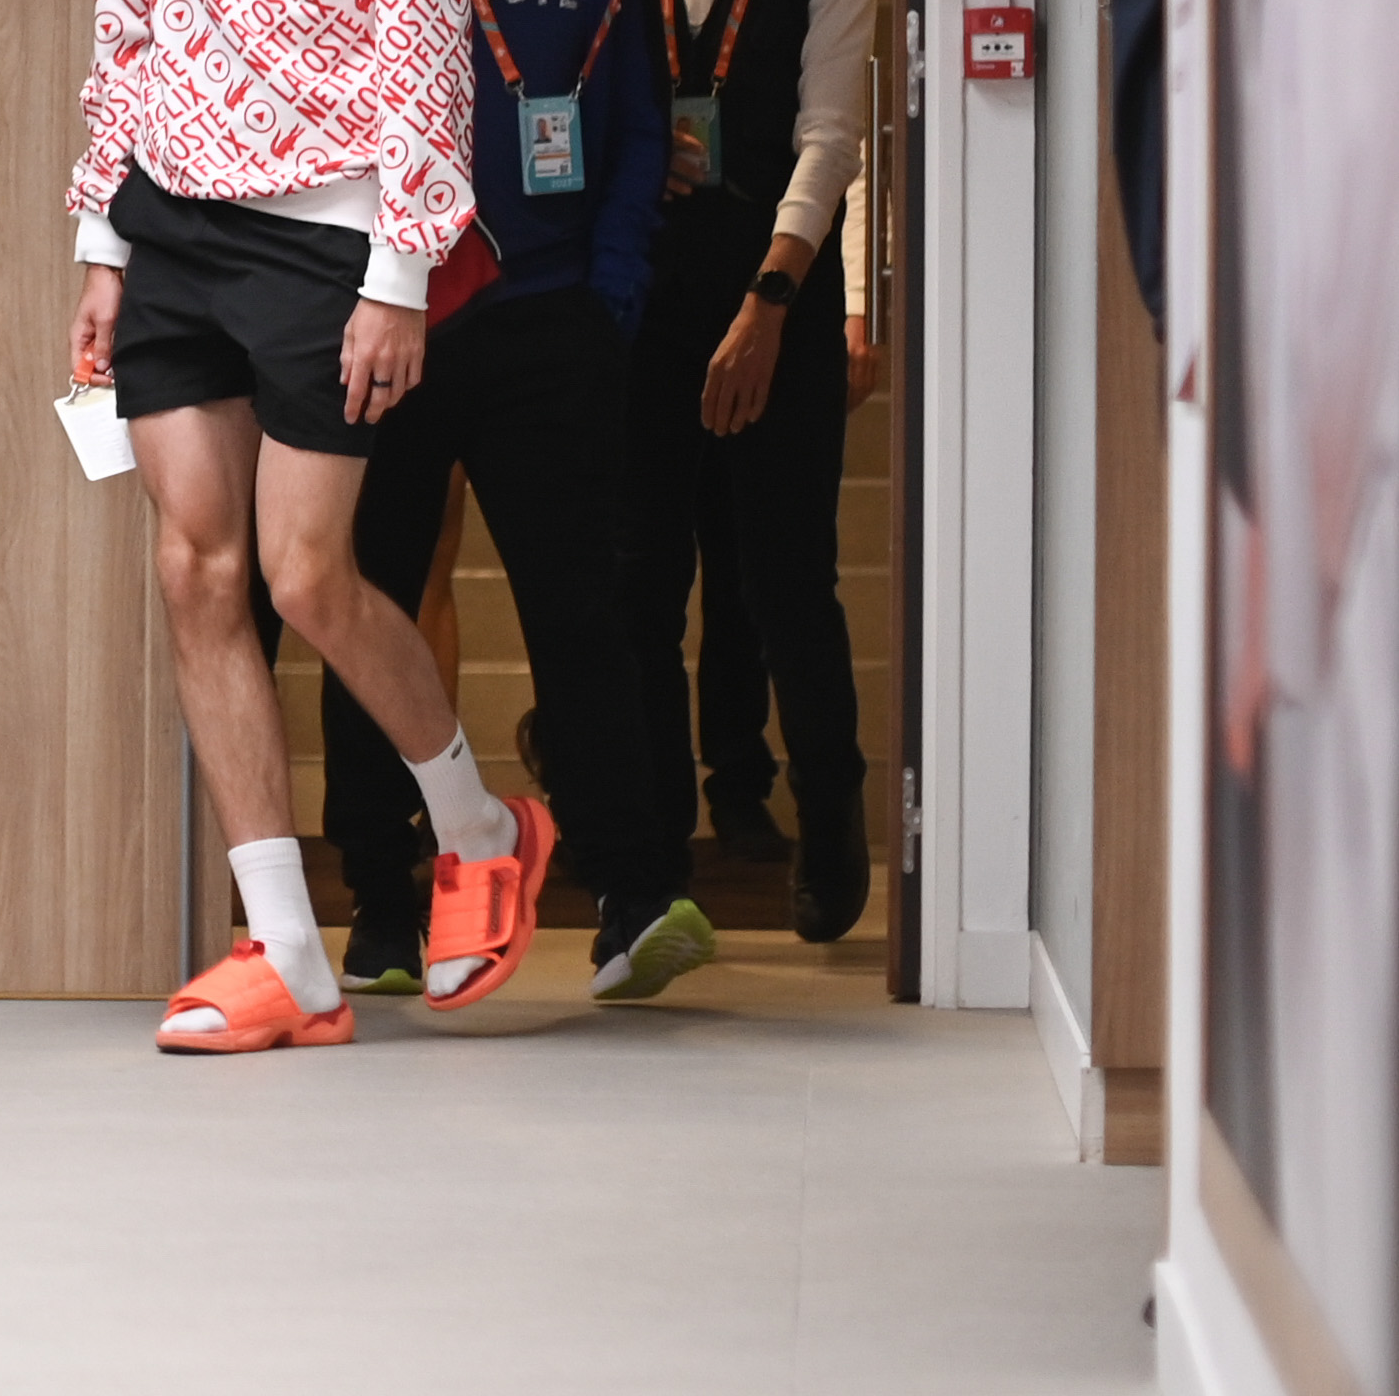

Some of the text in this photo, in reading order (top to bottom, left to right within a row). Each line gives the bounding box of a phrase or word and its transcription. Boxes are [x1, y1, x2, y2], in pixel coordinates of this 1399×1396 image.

[268, 10, 363, 105] LACOSTE
[295, 29, 376, 128] NETFLIX
[381, 9, 458, 115] NETFLIX
